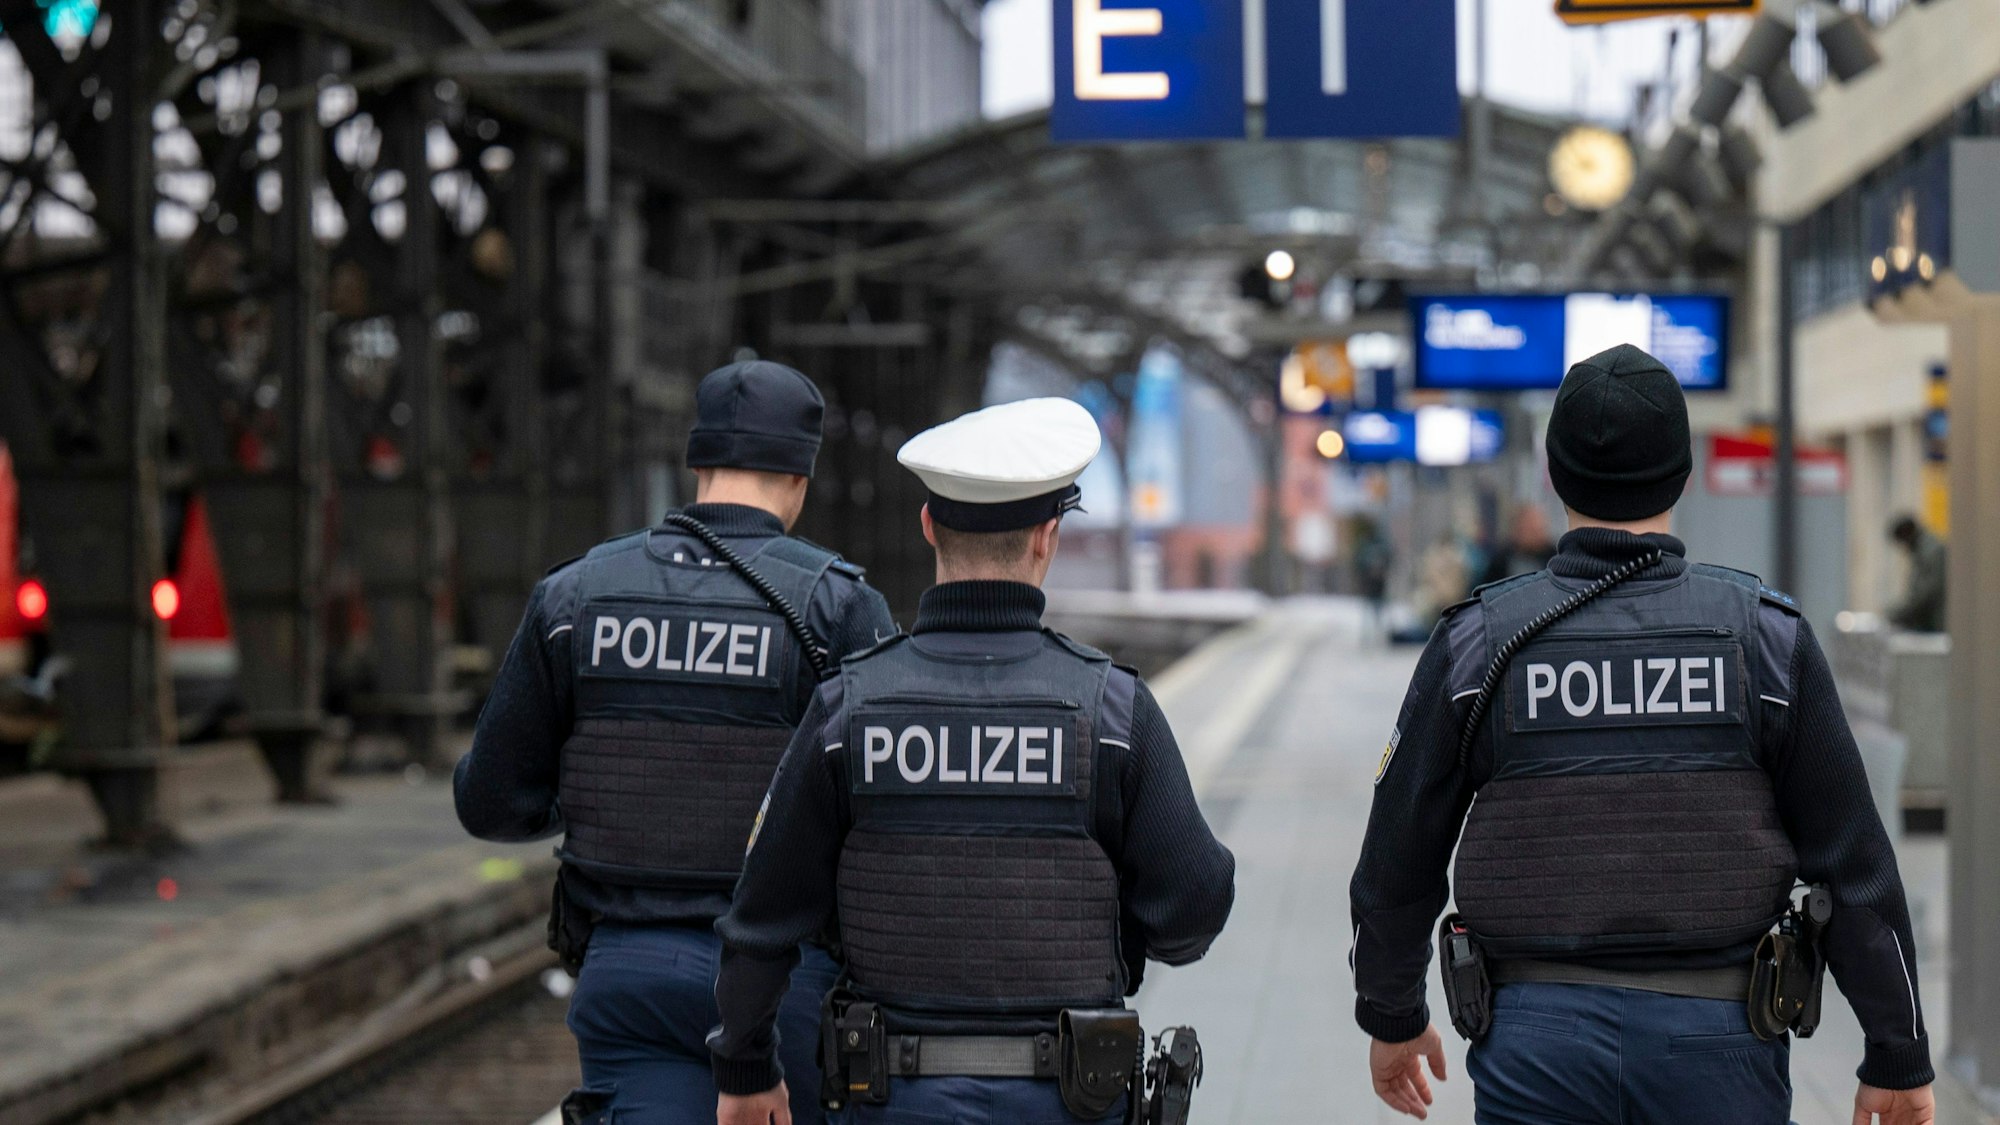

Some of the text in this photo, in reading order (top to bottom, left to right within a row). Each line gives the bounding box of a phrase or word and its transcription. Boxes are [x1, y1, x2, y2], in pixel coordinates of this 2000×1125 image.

[1074, 0, 1169, 99] E
[591, 616, 772, 677] POLIZEI
[1526, 656, 1725, 719] POLIZEI
[864, 725, 1063, 783] POLIZEI
